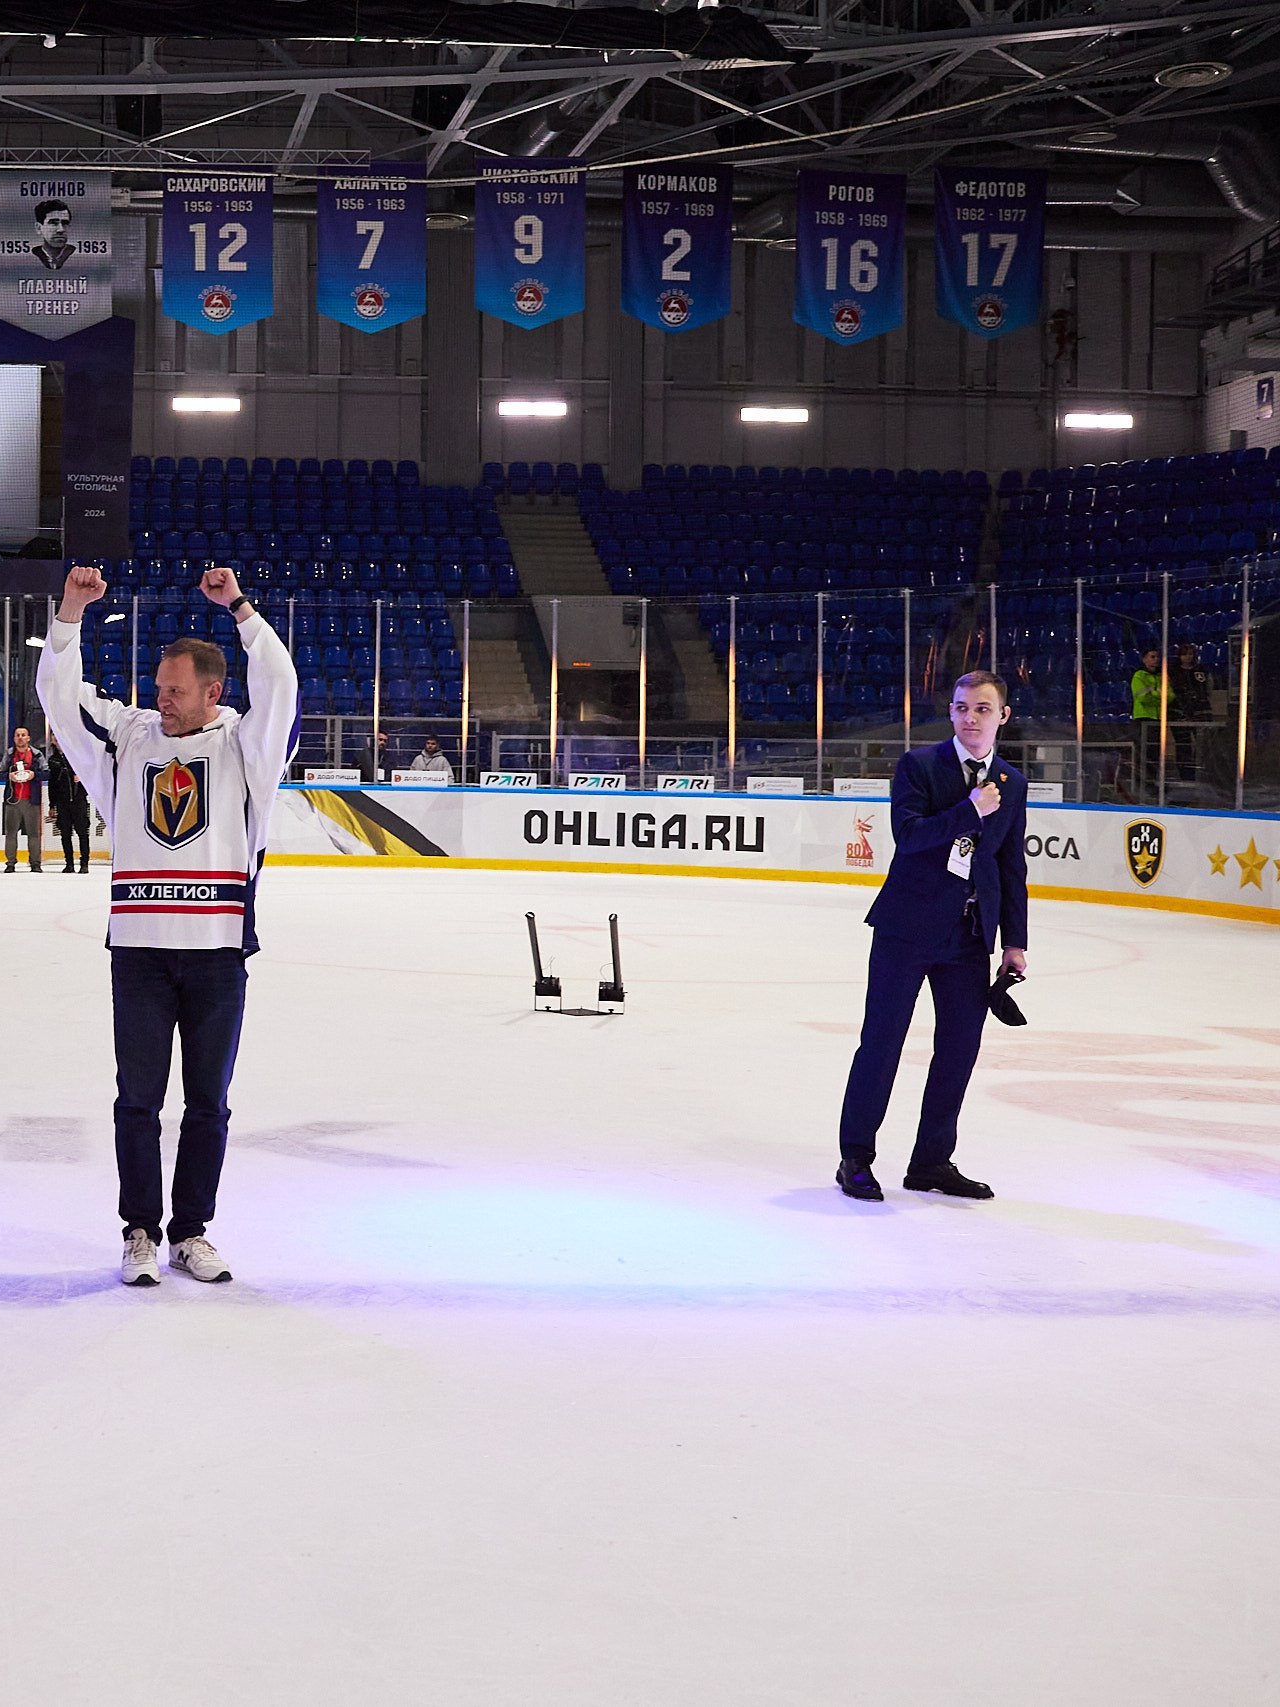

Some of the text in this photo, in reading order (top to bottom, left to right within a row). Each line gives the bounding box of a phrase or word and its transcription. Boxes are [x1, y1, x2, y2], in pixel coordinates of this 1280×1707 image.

[20, 181, 85, 197] БОГИНОВ
[637, 174, 718, 193] КОРМАКОВ
[955, 181, 1026, 199] ФЕДОТОВ
[496, 192, 525, 204] 1958
[537, 192, 564, 204] 1971
[828, 185, 874, 202] РОГОВ
[184, 201, 212, 213] 1956
[225, 200, 253, 212] 1963
[336, 198, 364, 210] 1956
[376, 199, 405, 210] 1963
[641, 201, 670, 214] 1957
[684, 203, 714, 217] 1969
[815, 211, 845, 225] 1958
[858, 213, 888, 228] 1969
[956, 207, 985, 221] 1962
[998, 208, 1027, 222] 1977
[189, 222, 247, 272] 12
[356, 220, 384, 269] 7
[514, 215, 543, 264] 9
[1, 241, 107, 254] 1955 1963
[661, 228, 692, 281] 2
[821, 238, 878, 292] 16
[961, 232, 1018, 287] 17
[17, 276, 88, 295] ГЛАВНЫЙ
[26, 300, 80, 315] ТРЕНЕР
[1261, 383, 1269, 402] 7
[67, 474, 125, 482] КУЛЬТУРНАЯ
[74, 483, 117, 492] СТОЛИЦА
[84, 509, 105, 517] 2024
[485, 775, 531, 786] PARI
[573, 777, 620, 789] PARI
[663, 778, 709, 790] PARI
[524, 809, 765, 852] OHLIGA.RU
[846, 843, 862, 857] 80
[846, 858, 873, 867] ПОБЕДА!
[128, 885, 217, 899] ХК ЛЕГИОН
